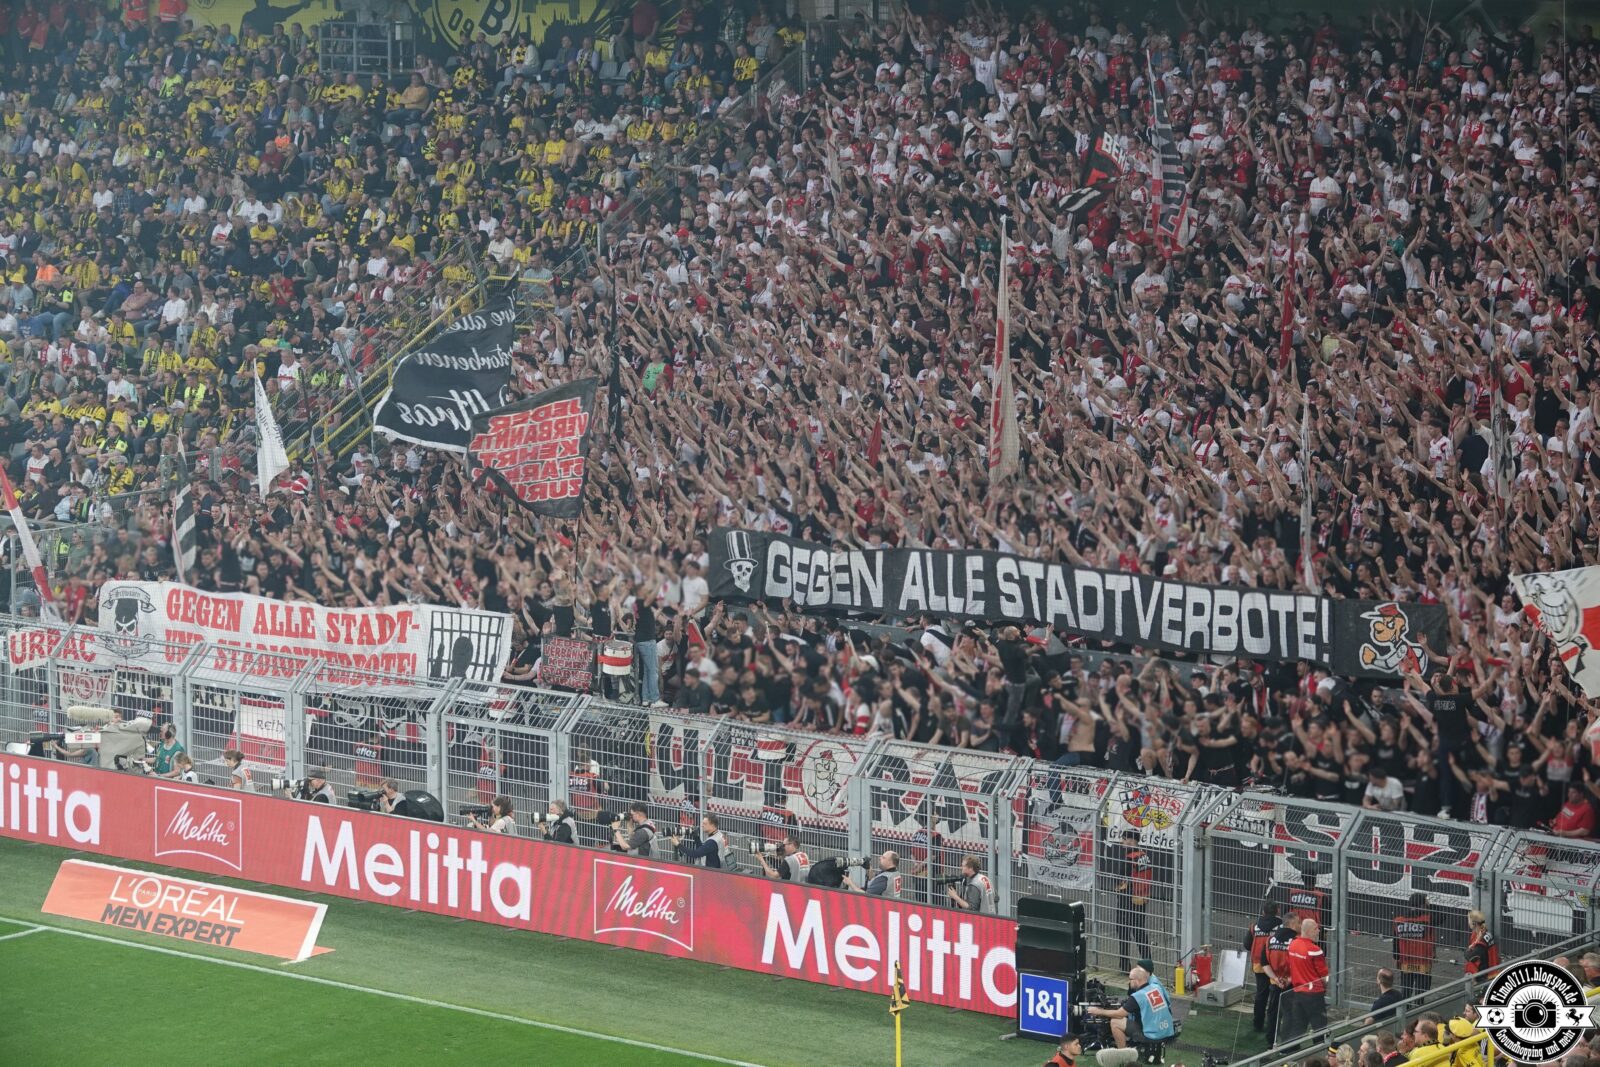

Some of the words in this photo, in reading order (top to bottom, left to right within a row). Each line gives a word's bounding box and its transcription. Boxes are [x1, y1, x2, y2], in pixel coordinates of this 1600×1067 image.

[166, 588, 244, 633] GEGEN
[252, 602, 316, 640] ALLE
[326, 610, 420, 646] STADT-
[765, 539, 884, 608] GEGEN
[898, 550, 986, 616] ALLE
[995, 557, 1330, 664] STADTVERBOTE!
[164, 801, 230, 846] Melitta
[761, 808, 784, 825] atlas
[301, 815, 532, 921] Melitta
[109, 875, 245, 925] L'ORÉAL
[604, 875, 680, 924] Melitta
[1291, 893, 1317, 905] atlas
[100, 903, 153, 931] MEN
[152, 912, 242, 947] EXPERT
[1397, 921, 1425, 934] atlas
[1024, 987, 1063, 1022] 1&1
